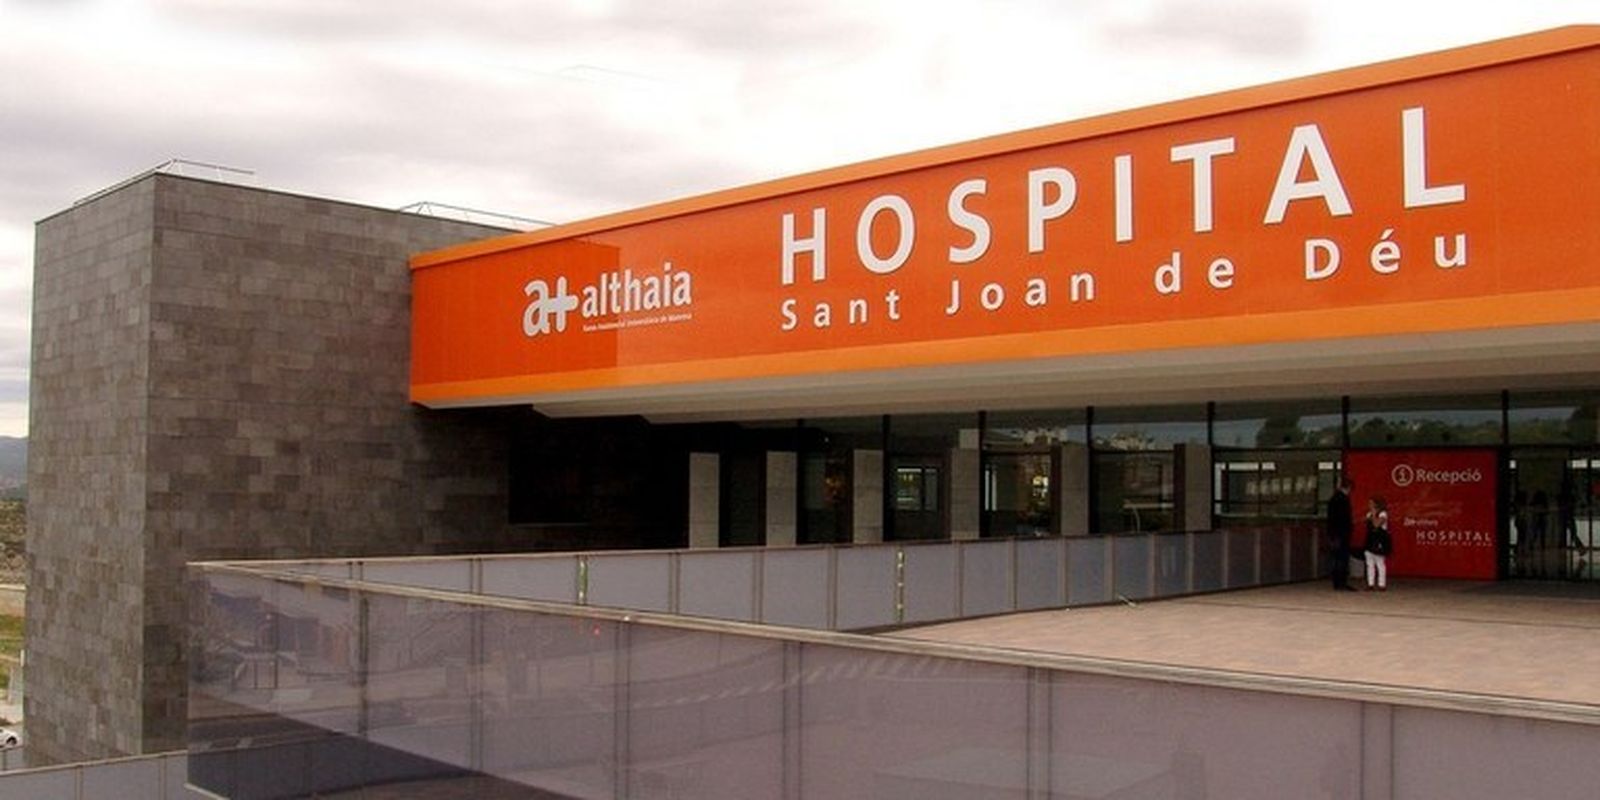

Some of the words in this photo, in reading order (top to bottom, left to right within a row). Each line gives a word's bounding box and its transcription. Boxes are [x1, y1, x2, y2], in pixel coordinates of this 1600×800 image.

[781, 106, 1467, 285] HOSPITAL
[582, 262, 692, 318] althaia
[781, 287, 901, 331] Sant
[945, 271, 1096, 315] Joan
[1154, 251, 1236, 294] de
[1304, 228, 1468, 281] Déu
[1415, 468, 1482, 484] Recepció
[1416, 530, 1491, 541] HOSPITAL
